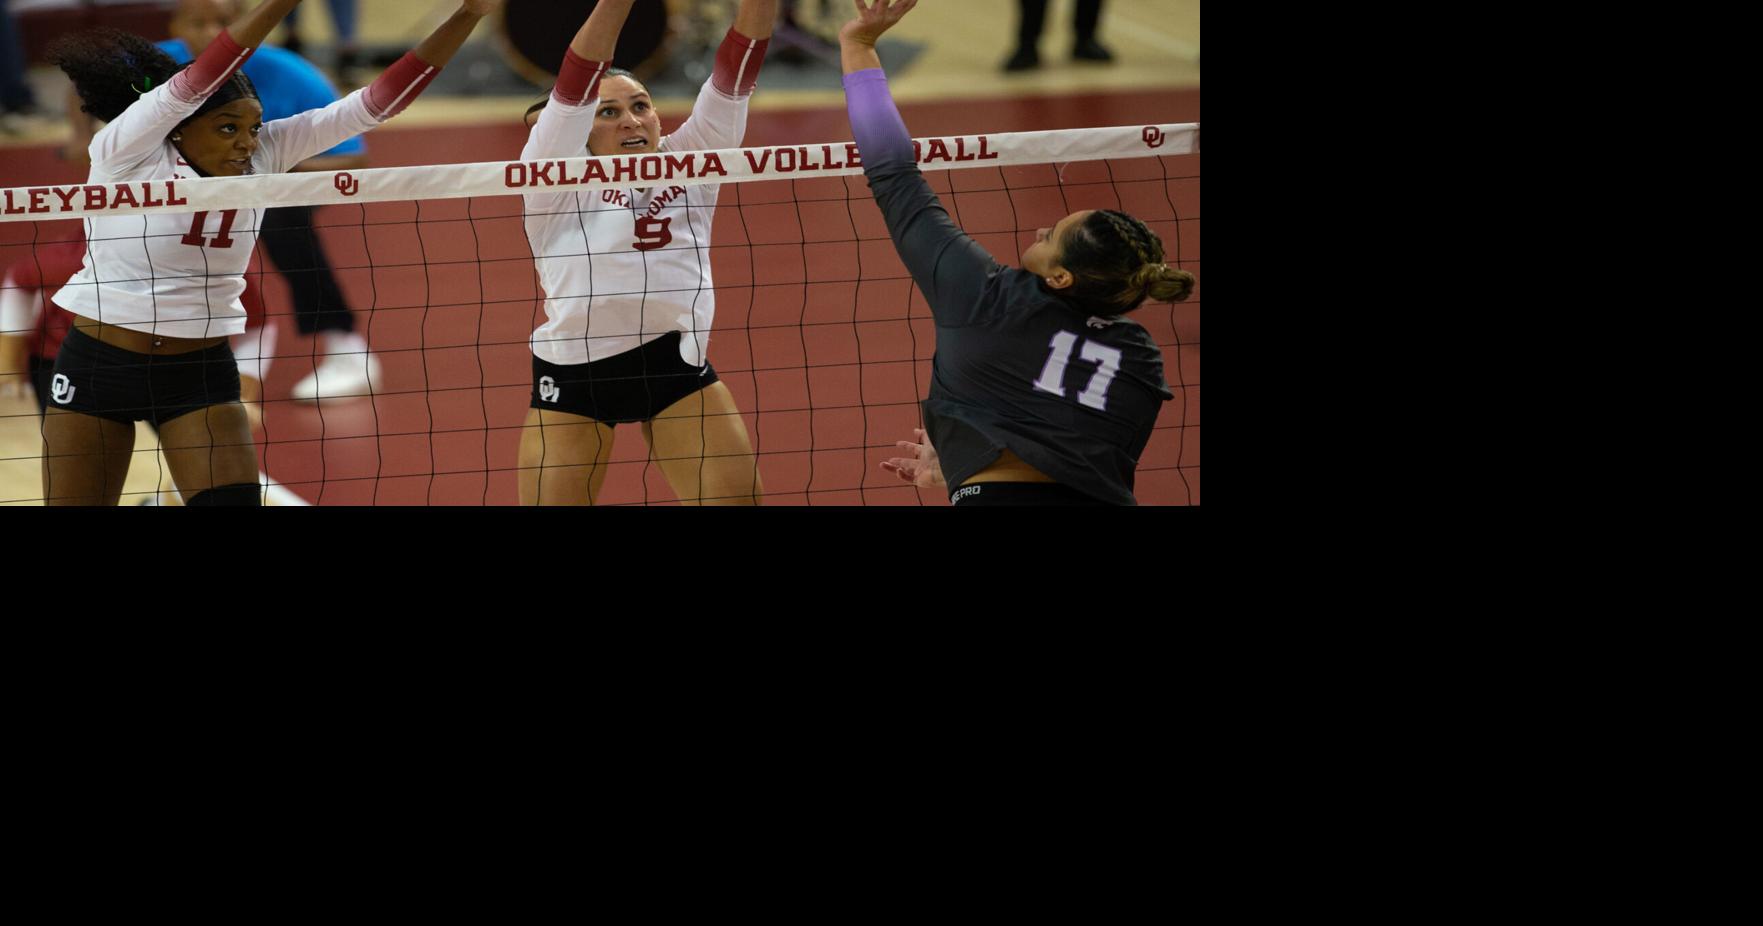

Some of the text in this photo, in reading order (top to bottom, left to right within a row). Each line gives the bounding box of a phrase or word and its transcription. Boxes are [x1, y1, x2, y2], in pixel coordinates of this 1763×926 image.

[504, 152, 728, 188] OKLAHOMA
[0, 180, 187, 215] LEYBALL
[181, 209, 238, 248] 11
[632, 216, 672, 251] 9
[1032, 329, 1122, 411] 17
